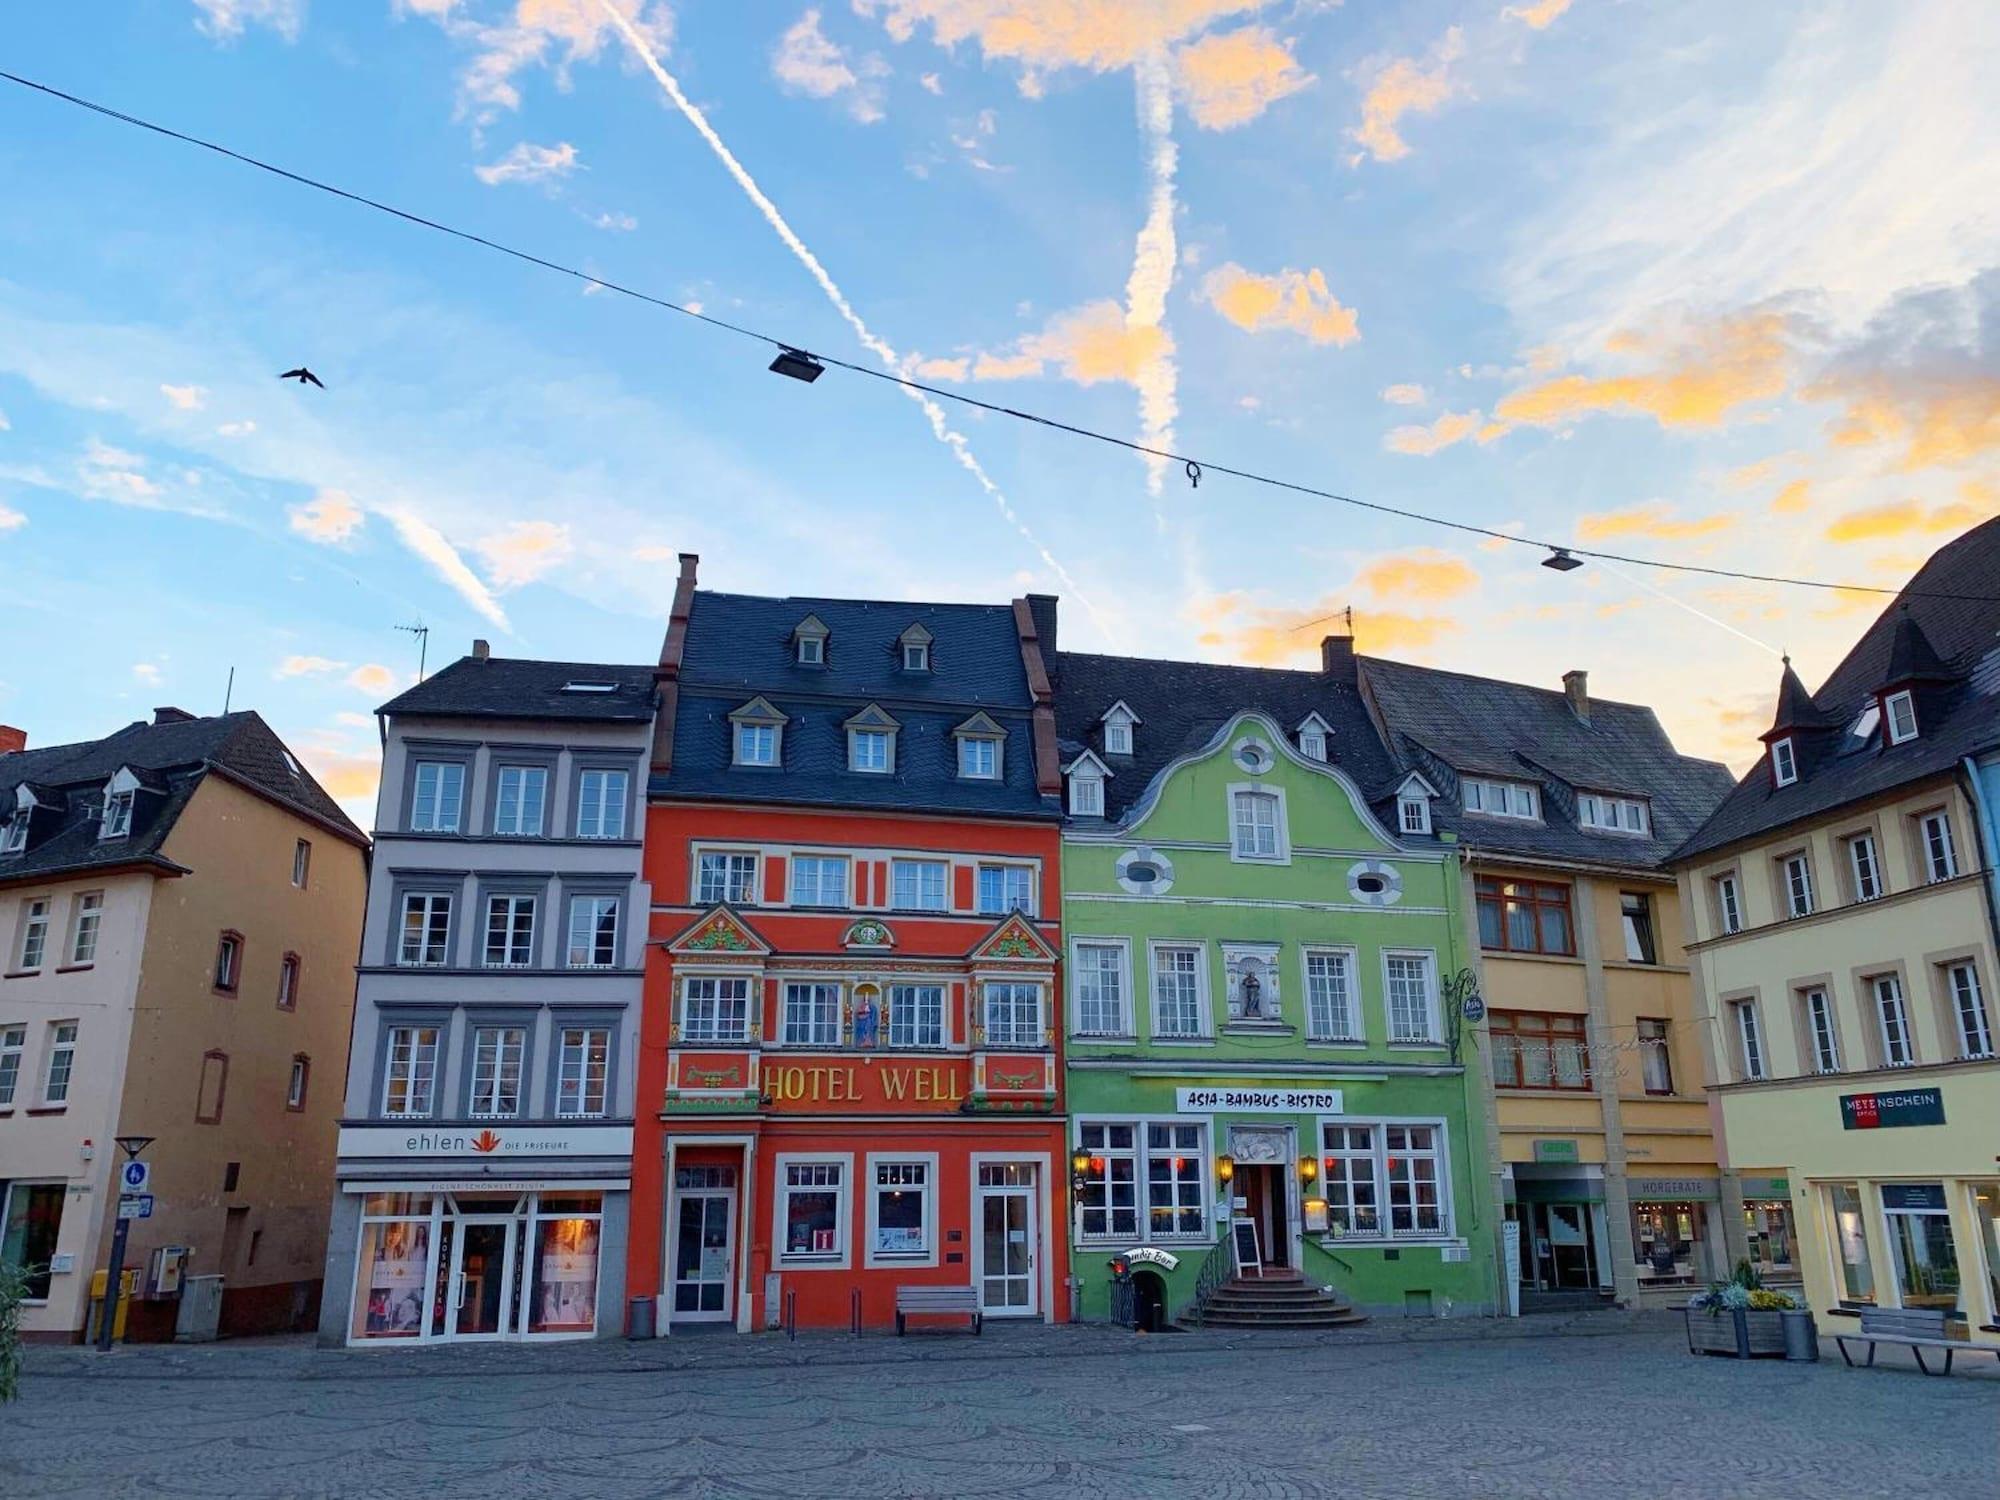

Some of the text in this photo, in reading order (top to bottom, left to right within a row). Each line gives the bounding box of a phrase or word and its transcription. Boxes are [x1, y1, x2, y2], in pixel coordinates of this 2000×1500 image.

[764, 1066, 964, 1101] HOTEL WELL
[1188, 1092, 1333, 1108] ASIA-BAMBUS-BISTRO
[407, 1134, 464, 1150] ehlen
